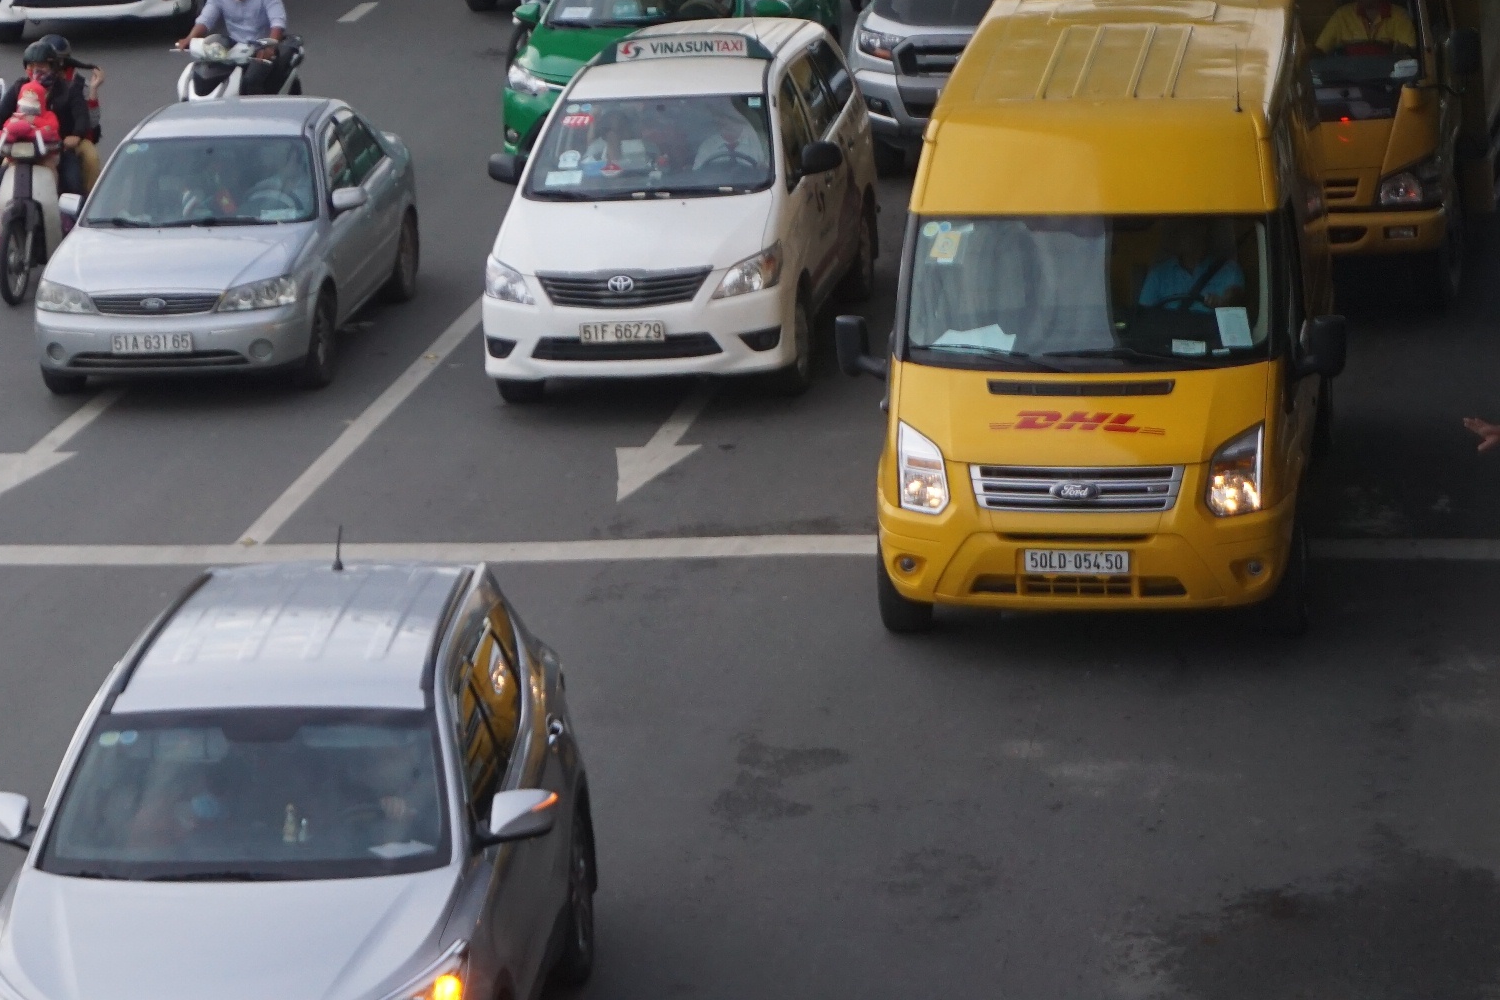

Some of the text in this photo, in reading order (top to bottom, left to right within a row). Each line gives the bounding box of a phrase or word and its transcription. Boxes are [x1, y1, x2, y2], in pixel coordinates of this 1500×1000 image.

[1013, 410, 1141, 433] DHL
[1060, 483, 1090, 498] Ford
[1030, 551, 1123, 570] 50LD-054.50
